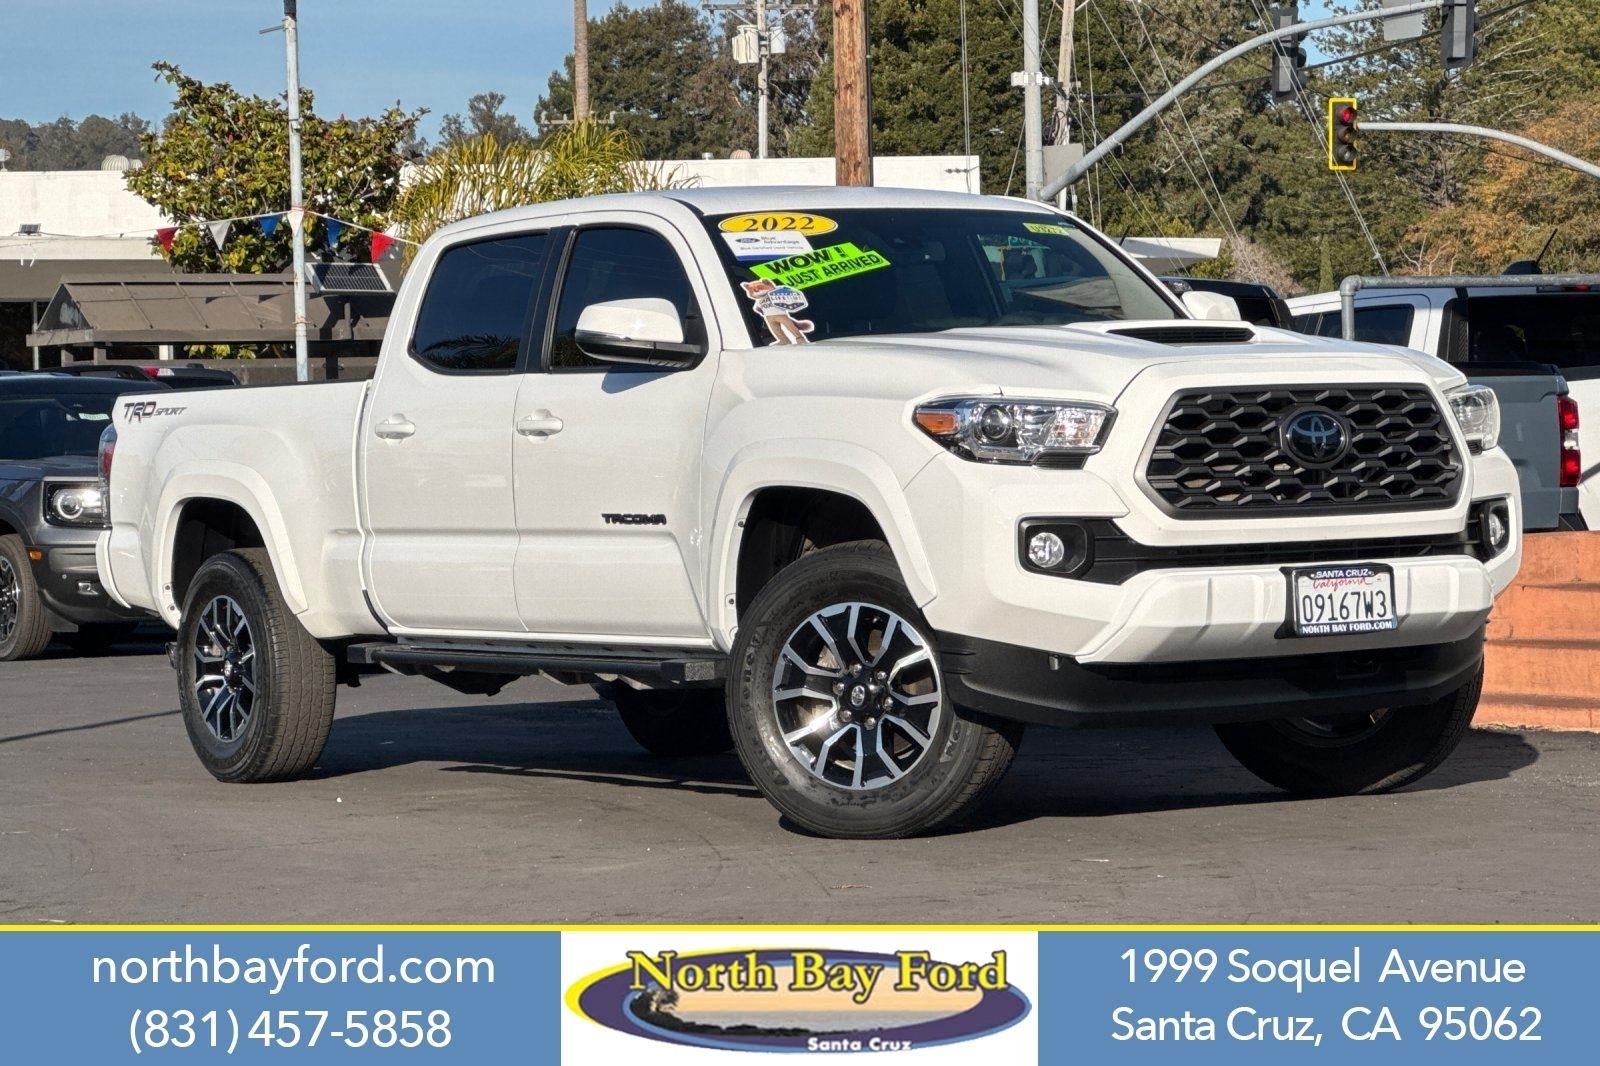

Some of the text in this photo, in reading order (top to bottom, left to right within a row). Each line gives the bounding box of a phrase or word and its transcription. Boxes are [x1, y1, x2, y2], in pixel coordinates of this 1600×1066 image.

[742, 216, 815, 232] 2022
[765, 249, 832, 276] WOW
[784, 254, 884, 287] JUST ARRIVED
[124, 401, 157, 424] TRD
[154, 407, 187, 416] SPORT
[601, 513, 667, 525] TACOMA
[1315, 569, 1369, 579] SANTA CRUZ
[1312, 577, 1373, 592] California
[1302, 590, 1387, 623] 09167W3
[1301, 621, 1393, 634] NORTH BAY FORD.COM
